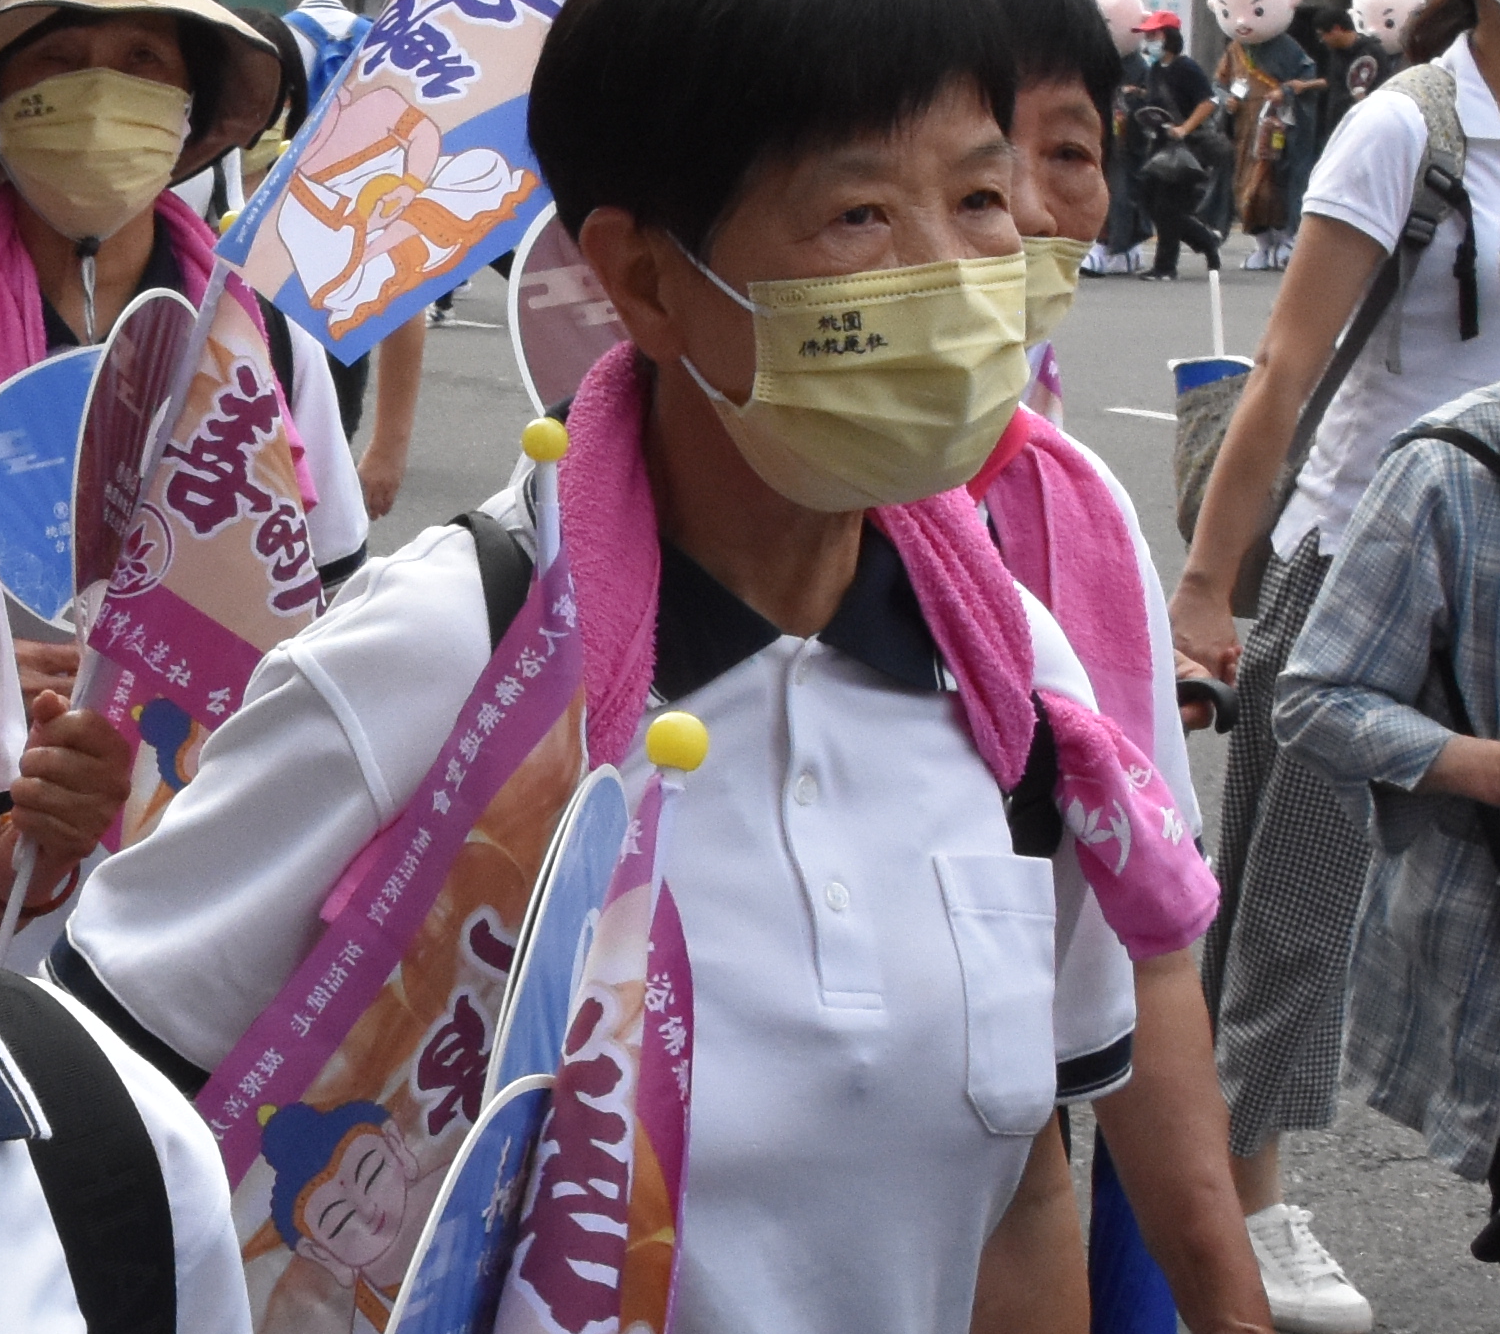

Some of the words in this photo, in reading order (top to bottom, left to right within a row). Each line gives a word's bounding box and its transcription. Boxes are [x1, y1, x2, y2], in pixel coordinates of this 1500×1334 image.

[818, 311, 862, 333] 桃園
[799, 331, 888, 357] 佛教蓮社
